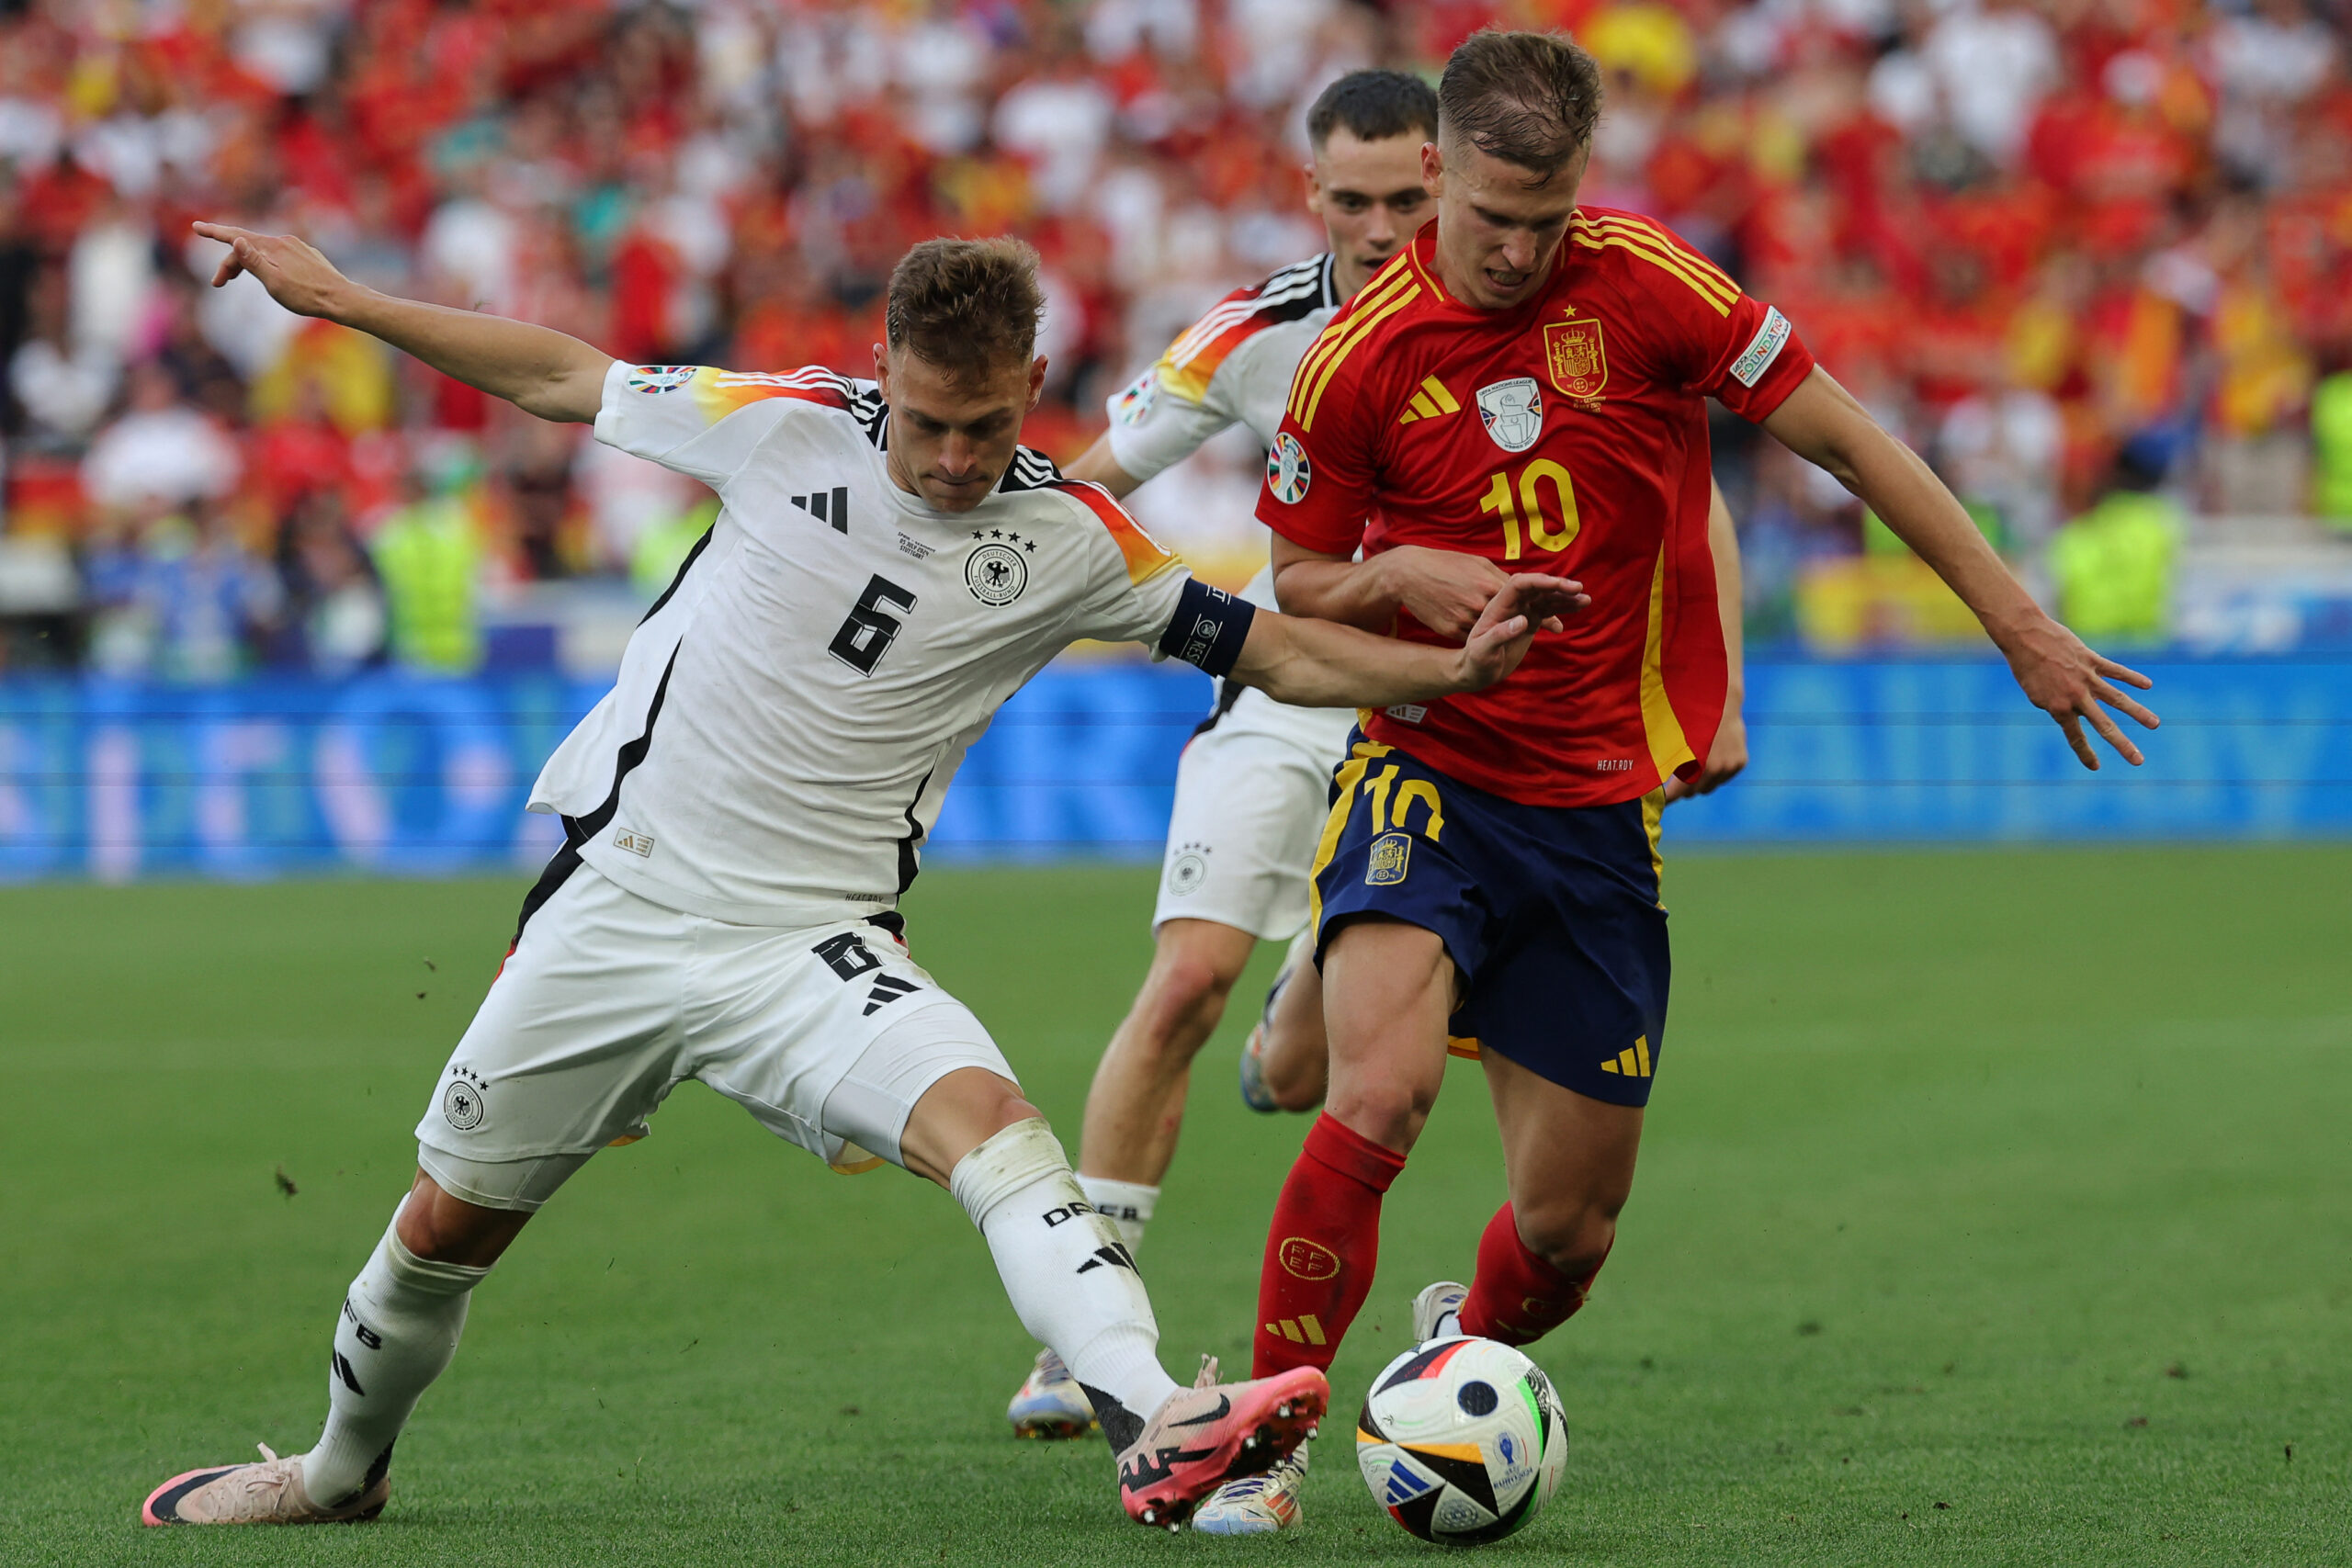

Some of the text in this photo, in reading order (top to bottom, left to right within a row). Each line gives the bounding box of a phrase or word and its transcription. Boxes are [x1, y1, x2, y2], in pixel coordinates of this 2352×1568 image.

[1479, 457, 1580, 560] 10
[899, 545, 924, 560] STUTTGART
[981, 553, 1017, 568] DEUTSCHER
[974, 575, 1016, 598] FUSSBALL-BUND
[828, 573, 918, 678] 6
[1364, 764, 1445, 842] 10
[811, 931, 887, 983] 6
[1042, 1202, 1097, 1227] DF
[345, 1298, 382, 1350] FB
